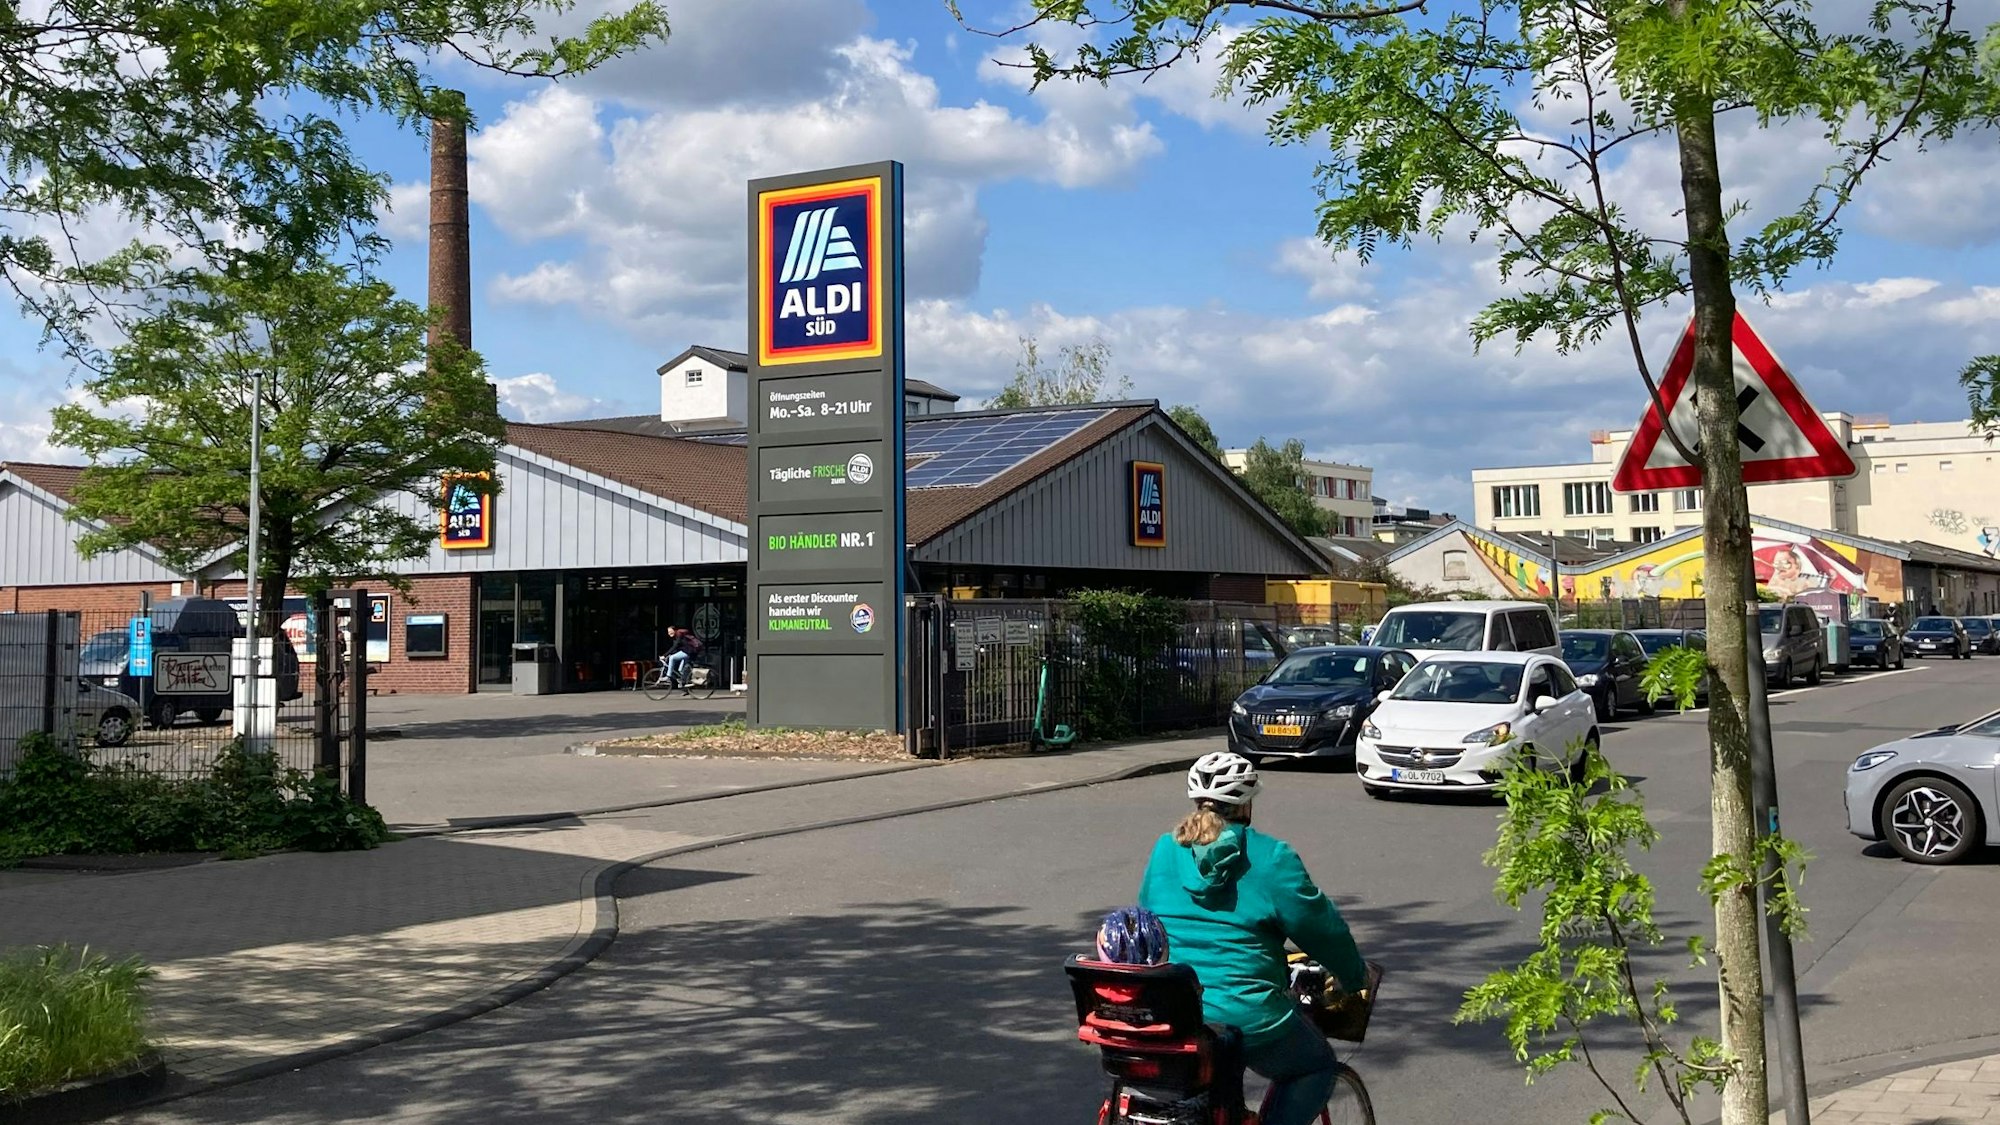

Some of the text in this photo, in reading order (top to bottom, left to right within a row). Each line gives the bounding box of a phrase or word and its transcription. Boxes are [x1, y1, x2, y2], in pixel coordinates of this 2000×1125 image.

[779, 282, 861, 319] ALDI
[806, 317, 836, 336] SÜD
[770, 390, 825, 402] Öffnungszeiten
[850, 399, 872, 413] Uhr
[770, 464, 846, 482] Tägliche FRISCHE
[850, 465, 869, 474] ALDI
[831, 477, 845, 485] zum
[1140, 509, 1161, 525] ALDI
[769, 535, 786, 550] BIO
[790, 531, 837, 549] HÄNDLER
[841, 532, 865, 547] NR.
[769, 592, 858, 604] Als erster Discounter
[769, 605, 822, 616] handeln wir
